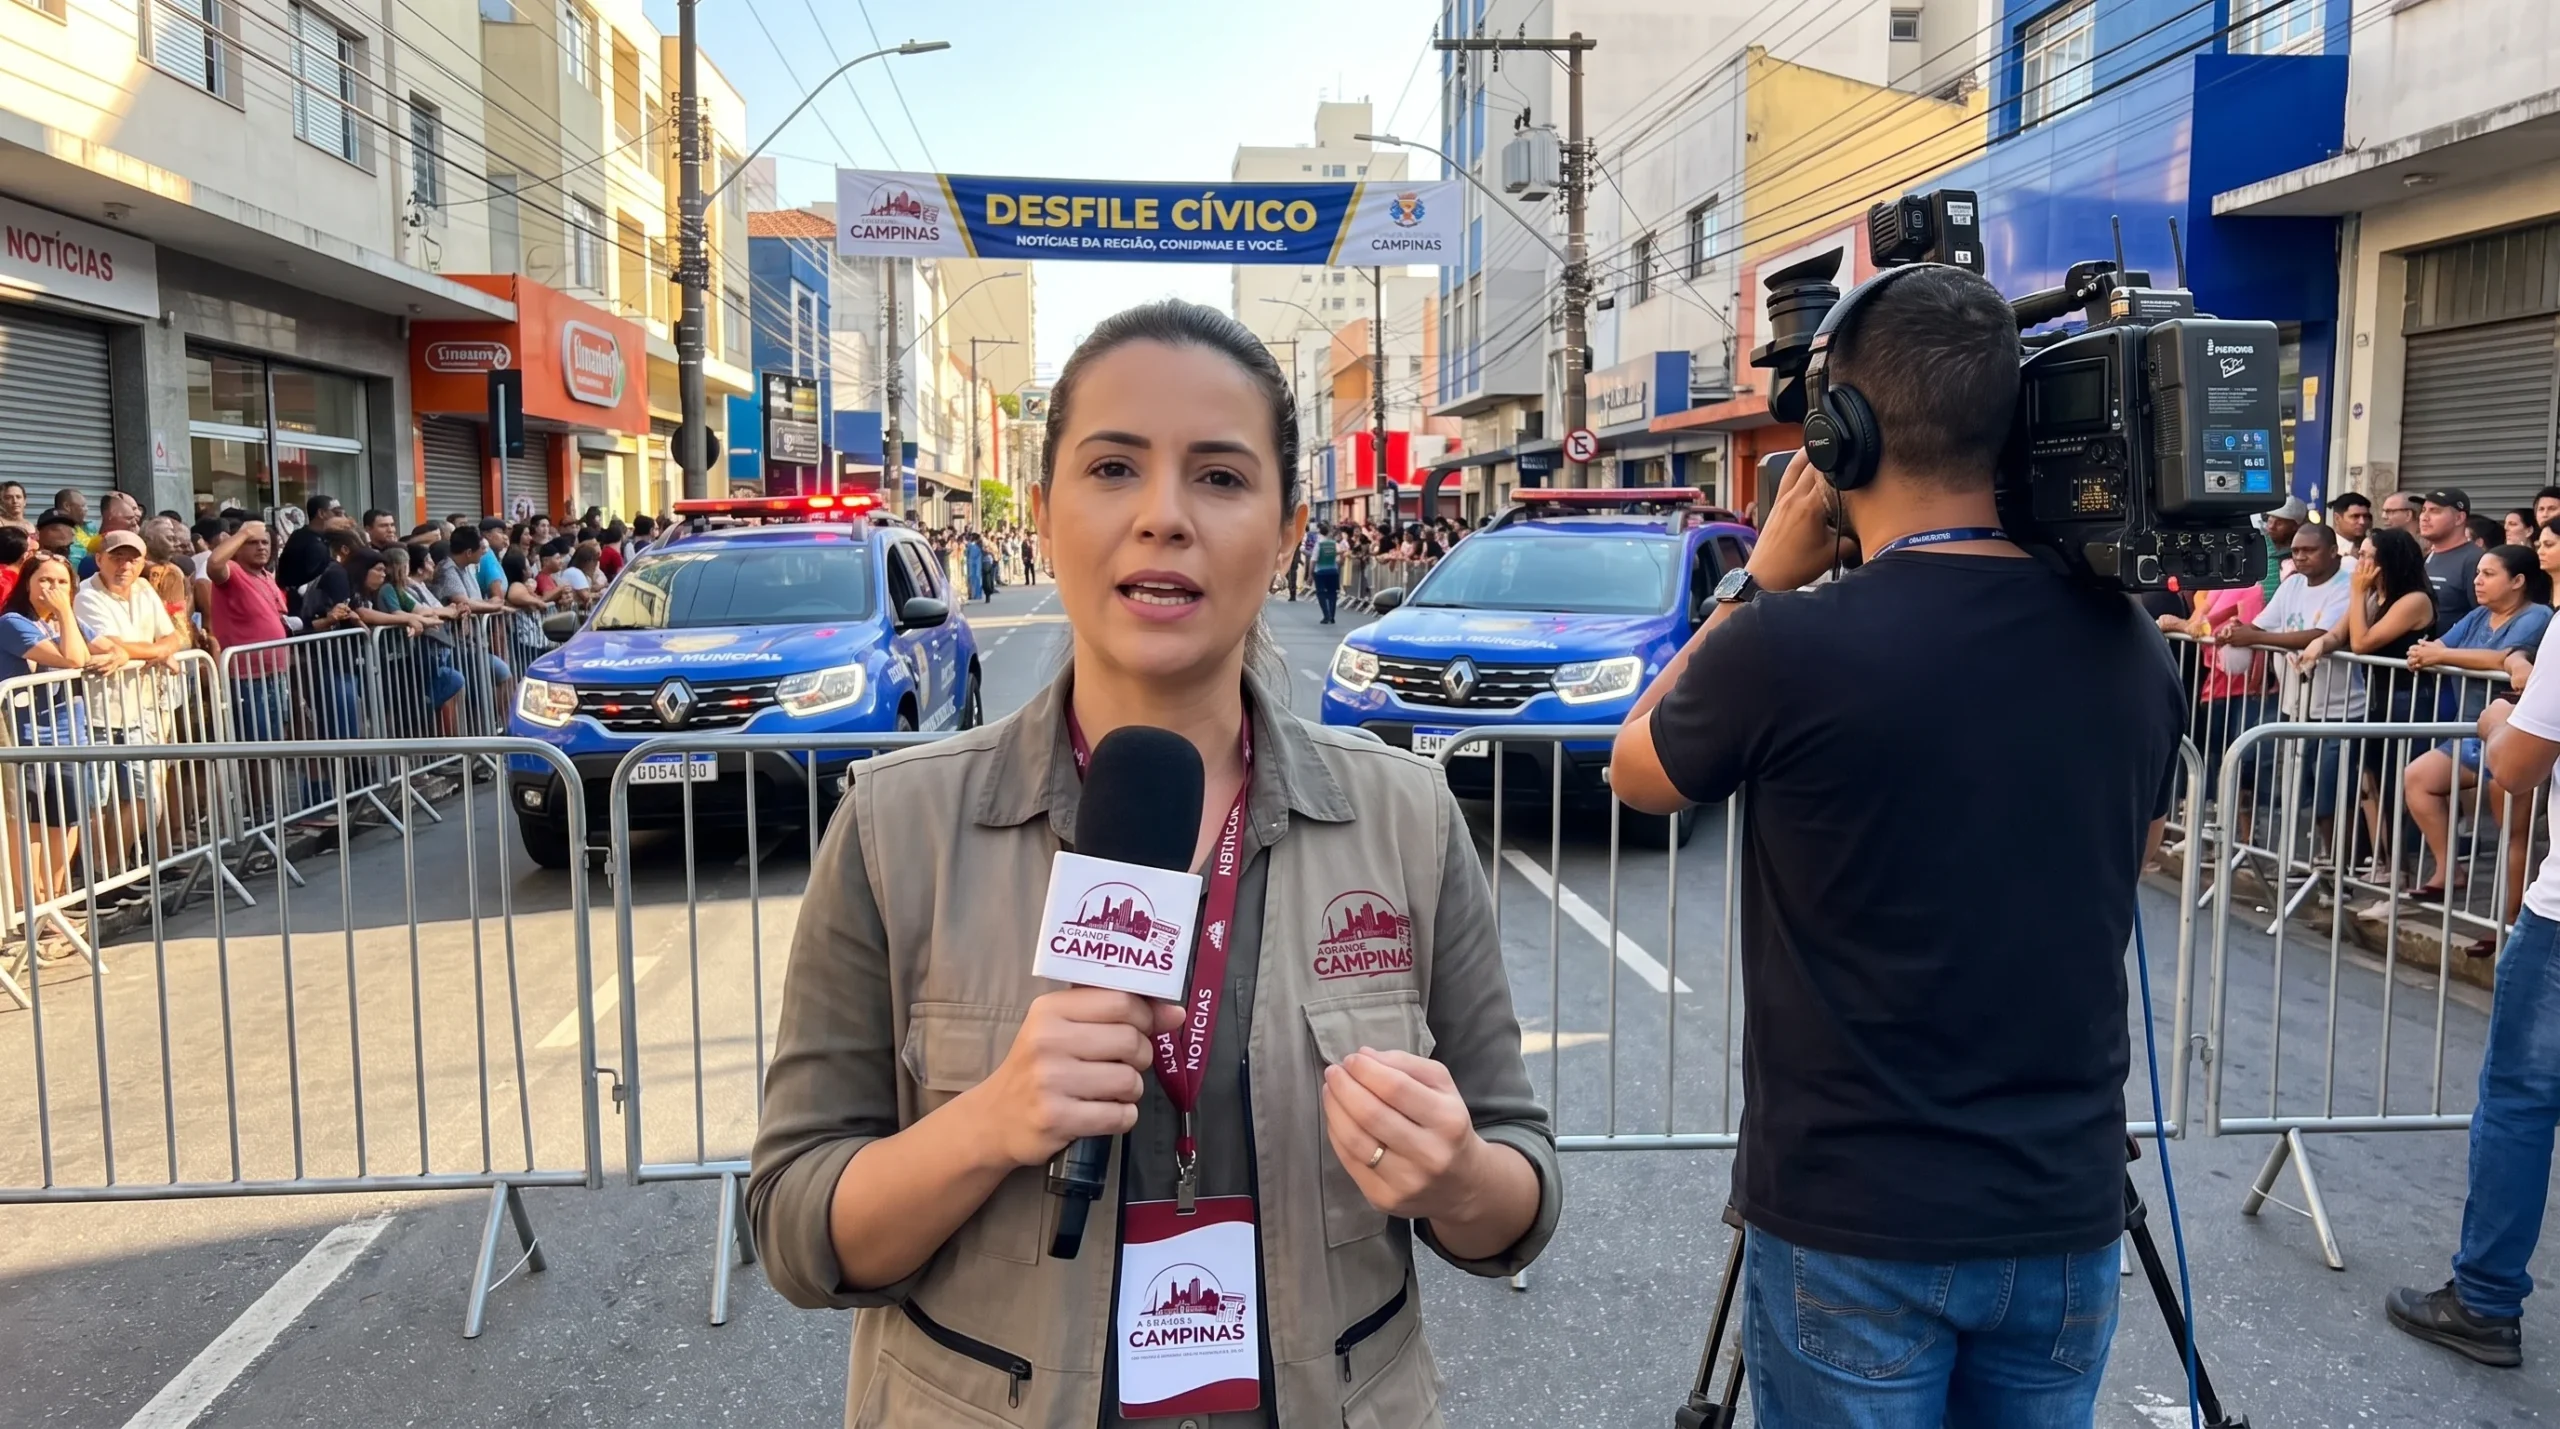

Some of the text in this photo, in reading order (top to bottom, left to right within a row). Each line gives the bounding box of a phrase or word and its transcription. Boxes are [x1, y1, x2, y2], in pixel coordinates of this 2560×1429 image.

[986, 191, 1318, 232] DESFILE CÍVICO
[850, 225, 940, 241] CAMPINAS
[1016, 234, 1079, 247] NOTÍCIAS
[1081, 237, 1101, 248] DA
[1103, 236, 1157, 251] REGIÃO,
[1236, 240, 1245, 250] E
[1247, 239, 1288, 251] VOCÊ.
[6, 225, 114, 281] NOTÍCIAS
[1371, 239, 1442, 251] CAMPINAS
[1066, 927, 1111, 942] GRANDE
[1050, 936, 1174, 971] CAMPINAS
[1313, 947, 1413, 975] CAMPINAS
[1129, 1324, 1245, 1347] CAMPINAS
